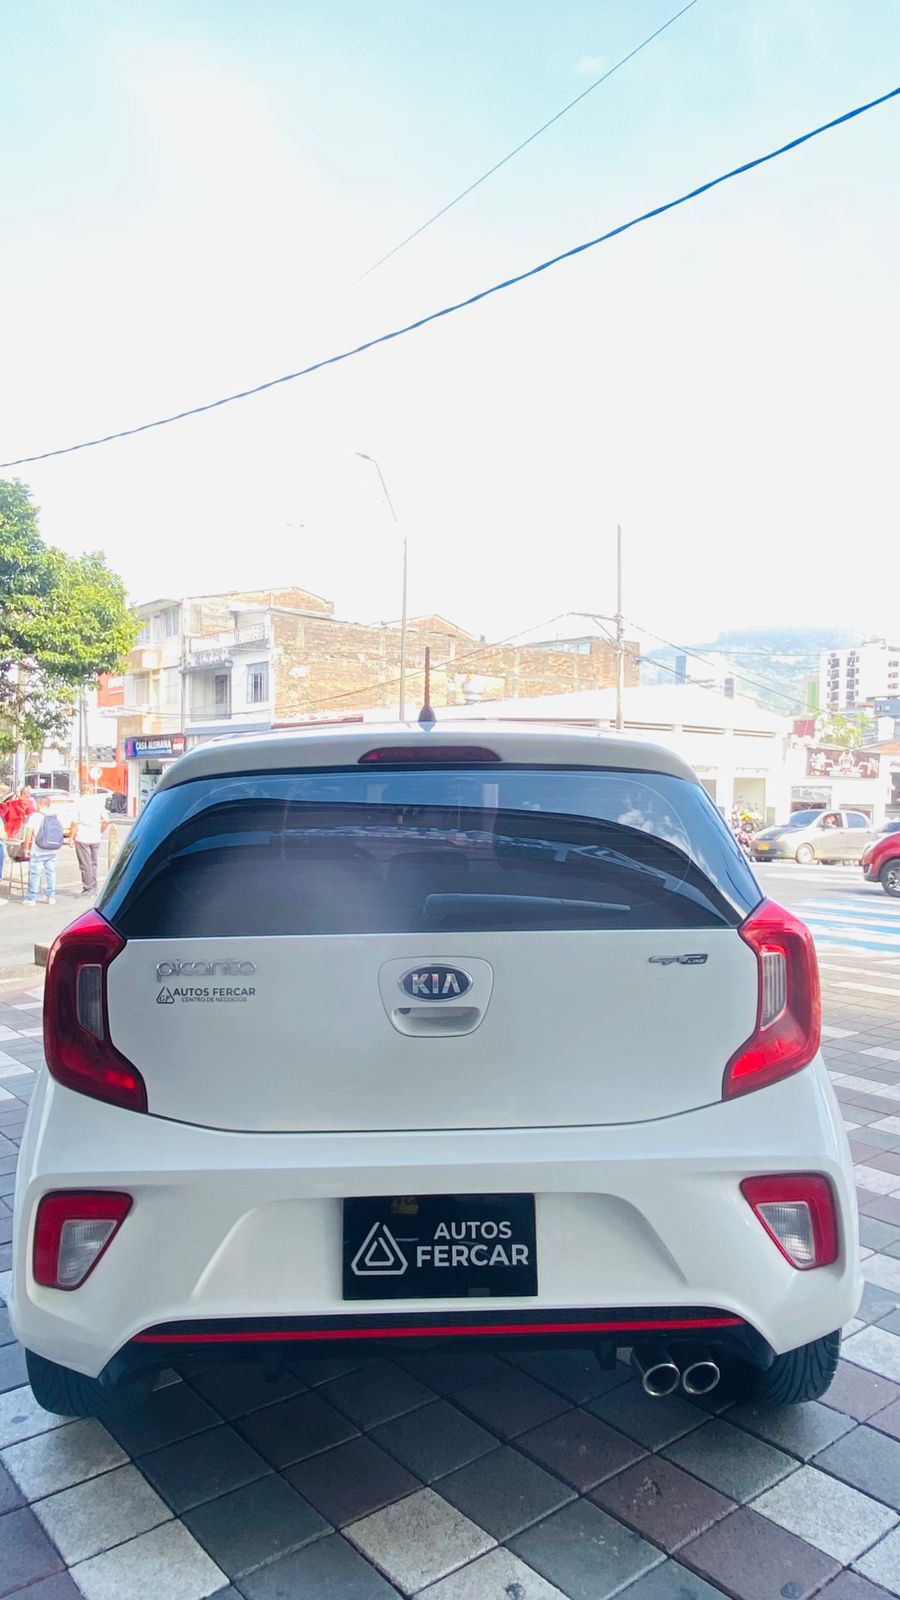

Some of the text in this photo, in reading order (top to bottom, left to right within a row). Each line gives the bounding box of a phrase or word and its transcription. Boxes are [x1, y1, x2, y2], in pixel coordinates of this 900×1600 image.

[135, 740, 148, 750] CASA
[156, 958, 257, 983] picanto
[173, 987, 256, 997] AUTOS FERCAR
[410, 972, 461, 994] KIA
[433, 1221, 513, 1240] AUTOS
[416, 1244, 530, 1267] FERCAR
